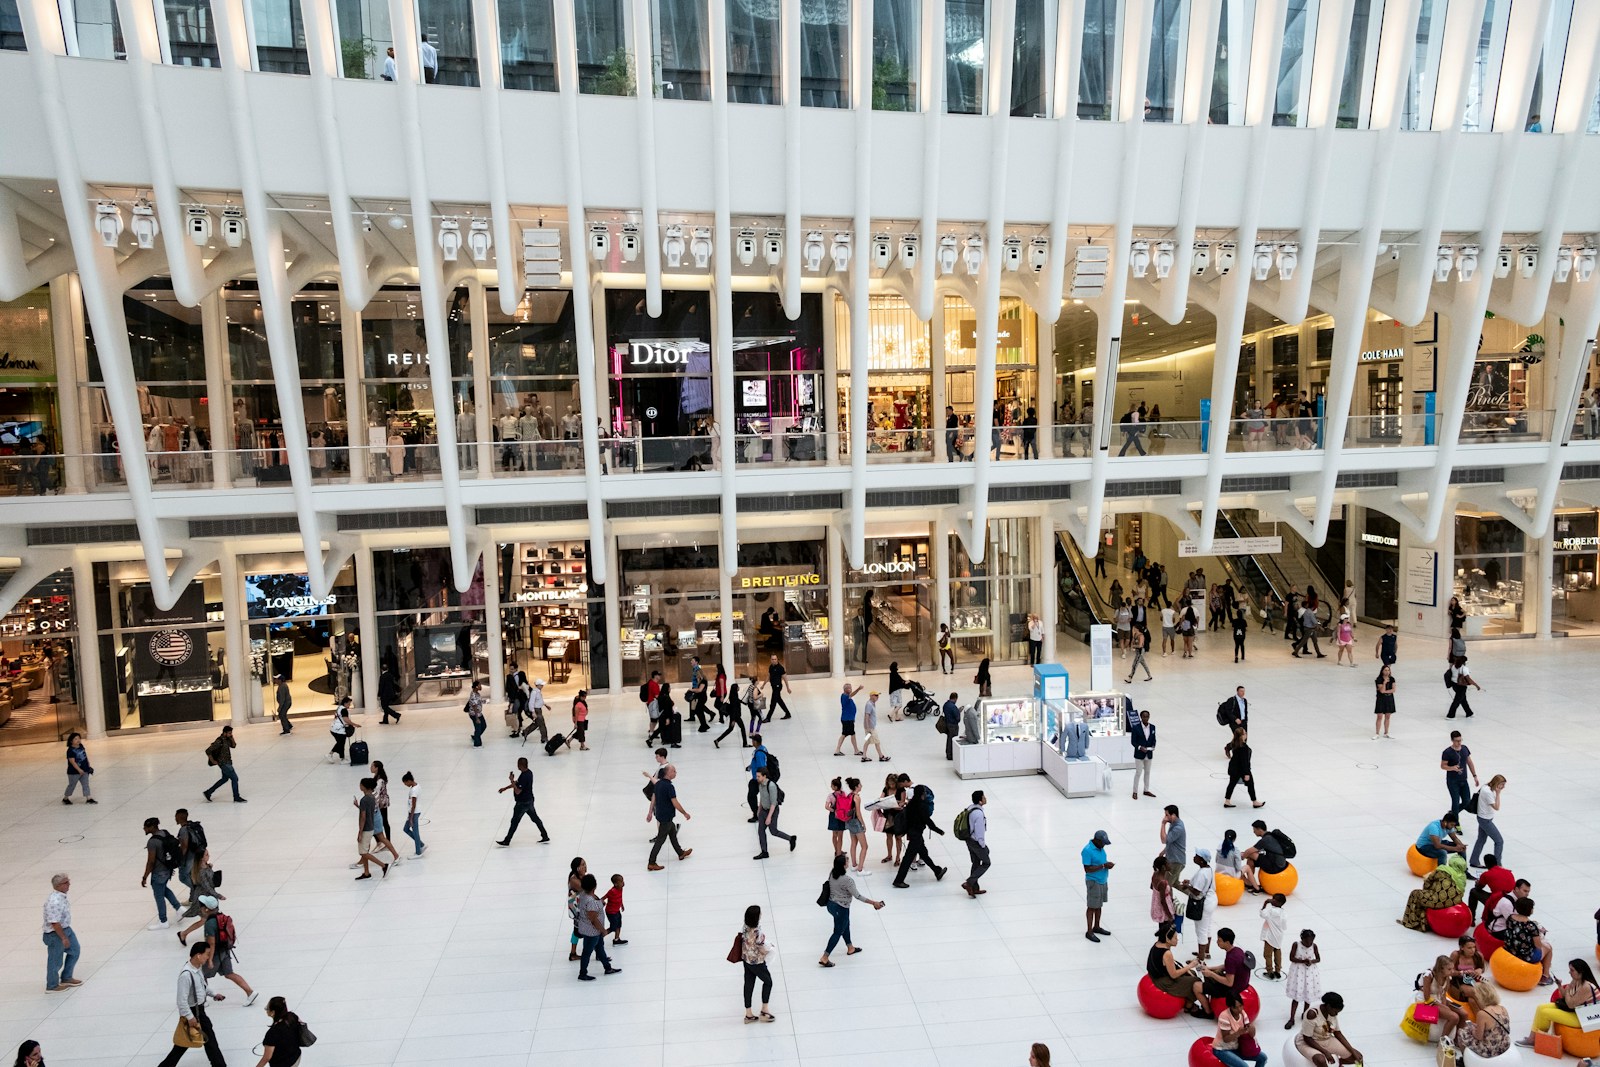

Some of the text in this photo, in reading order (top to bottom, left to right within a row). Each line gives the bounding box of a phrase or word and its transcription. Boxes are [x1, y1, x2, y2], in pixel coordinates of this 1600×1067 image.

[387, 353, 431, 365] REIS
[630, 342, 693, 365] Dior
[1361, 347, 1404, 361] COLE HAAN
[1465, 384, 1509, 411] Pinch
[863, 561, 916, 574] LONDON
[741, 574, 820, 588] BREITLING
[265, 594, 337, 609] LONGINS
[516, 590, 580, 602] MONTBLANC
